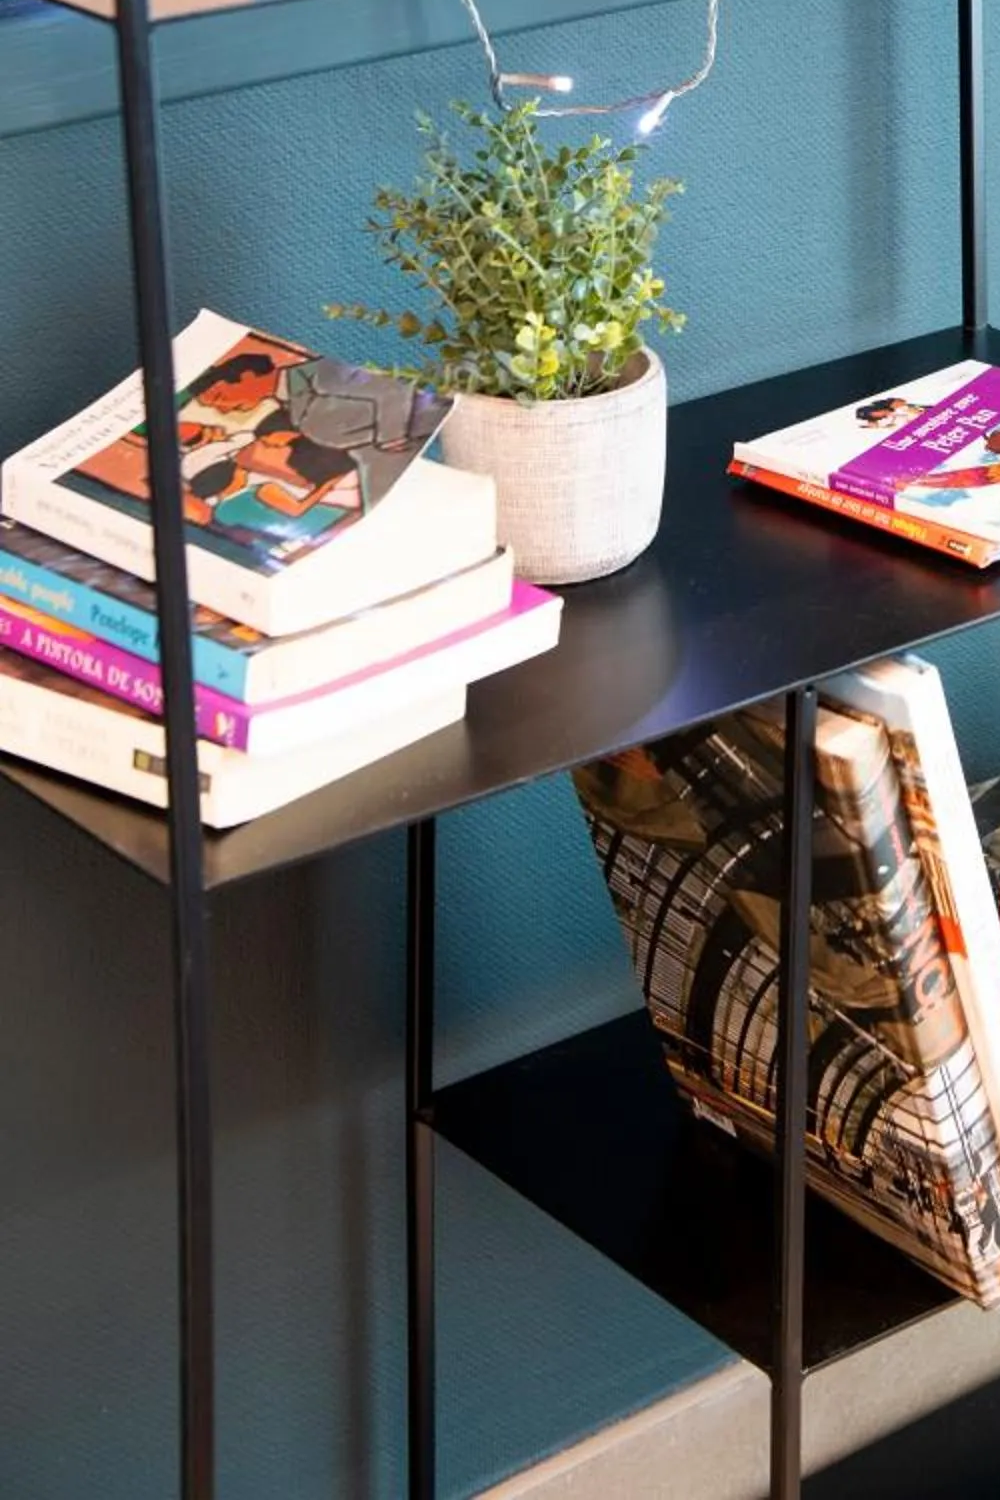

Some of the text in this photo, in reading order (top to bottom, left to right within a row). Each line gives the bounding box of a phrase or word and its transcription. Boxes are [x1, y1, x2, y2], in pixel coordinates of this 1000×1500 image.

[920, 408, 999, 454] Peter Pan
[19, 627, 33, 647] A
[35, 632, 103, 681] PINTORA
[107, 664, 130, 692] DE
